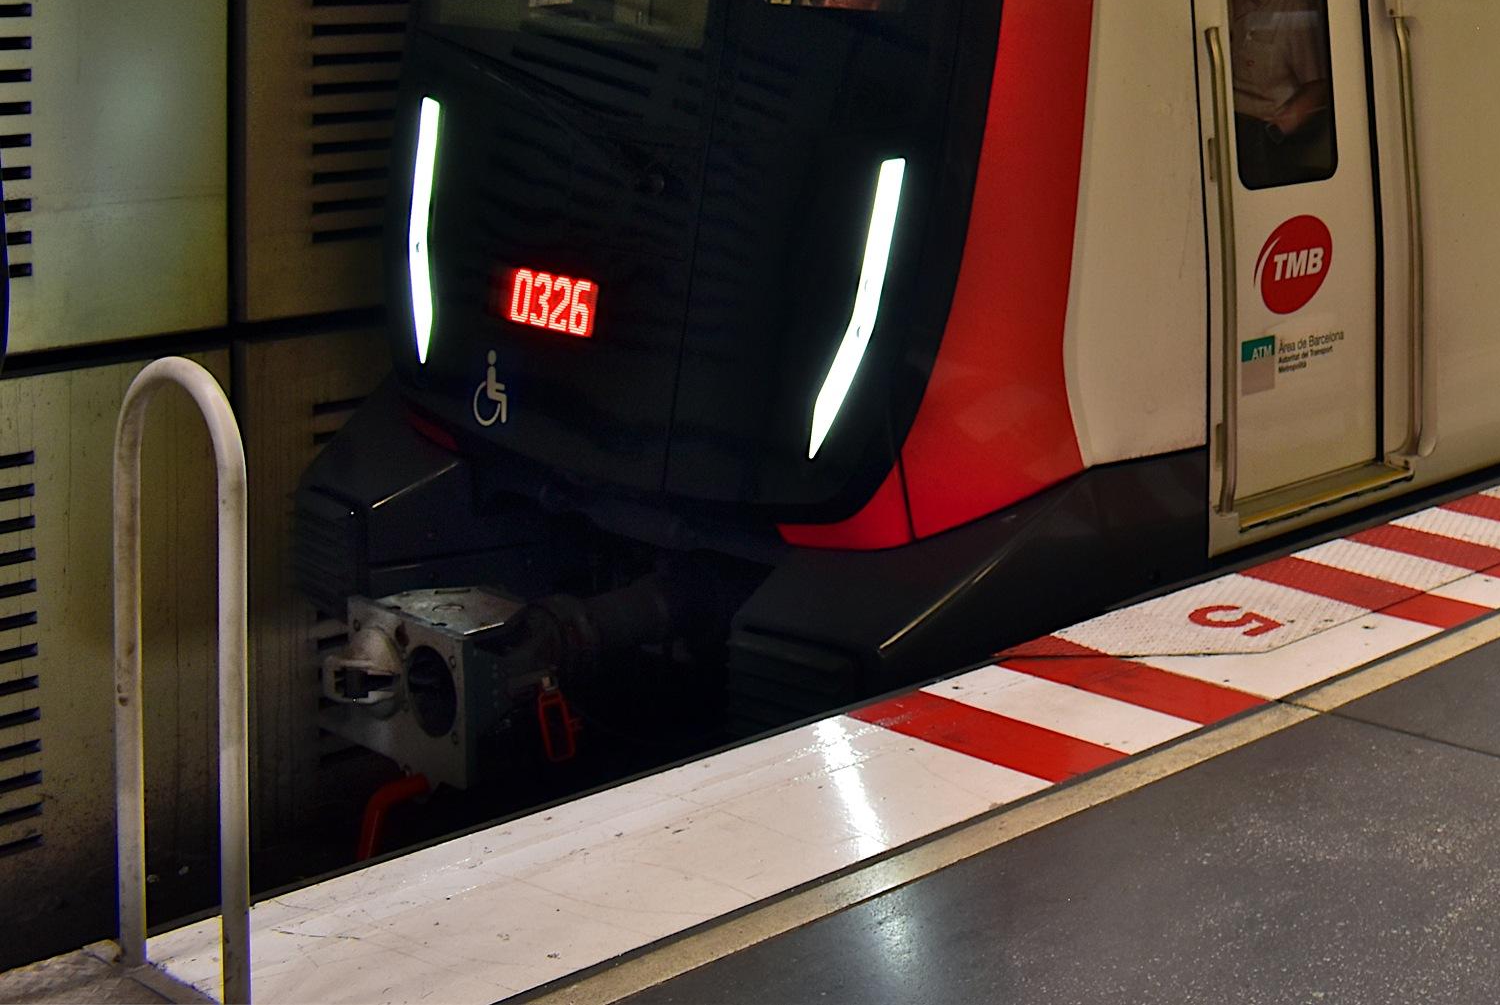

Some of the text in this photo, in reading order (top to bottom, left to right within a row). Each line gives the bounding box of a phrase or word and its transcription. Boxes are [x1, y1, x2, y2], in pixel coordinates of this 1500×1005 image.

[1273, 247, 1325, 282] TMB
[510, 269, 591, 336] 0326
[1188, 604, 1285, 637] 5
